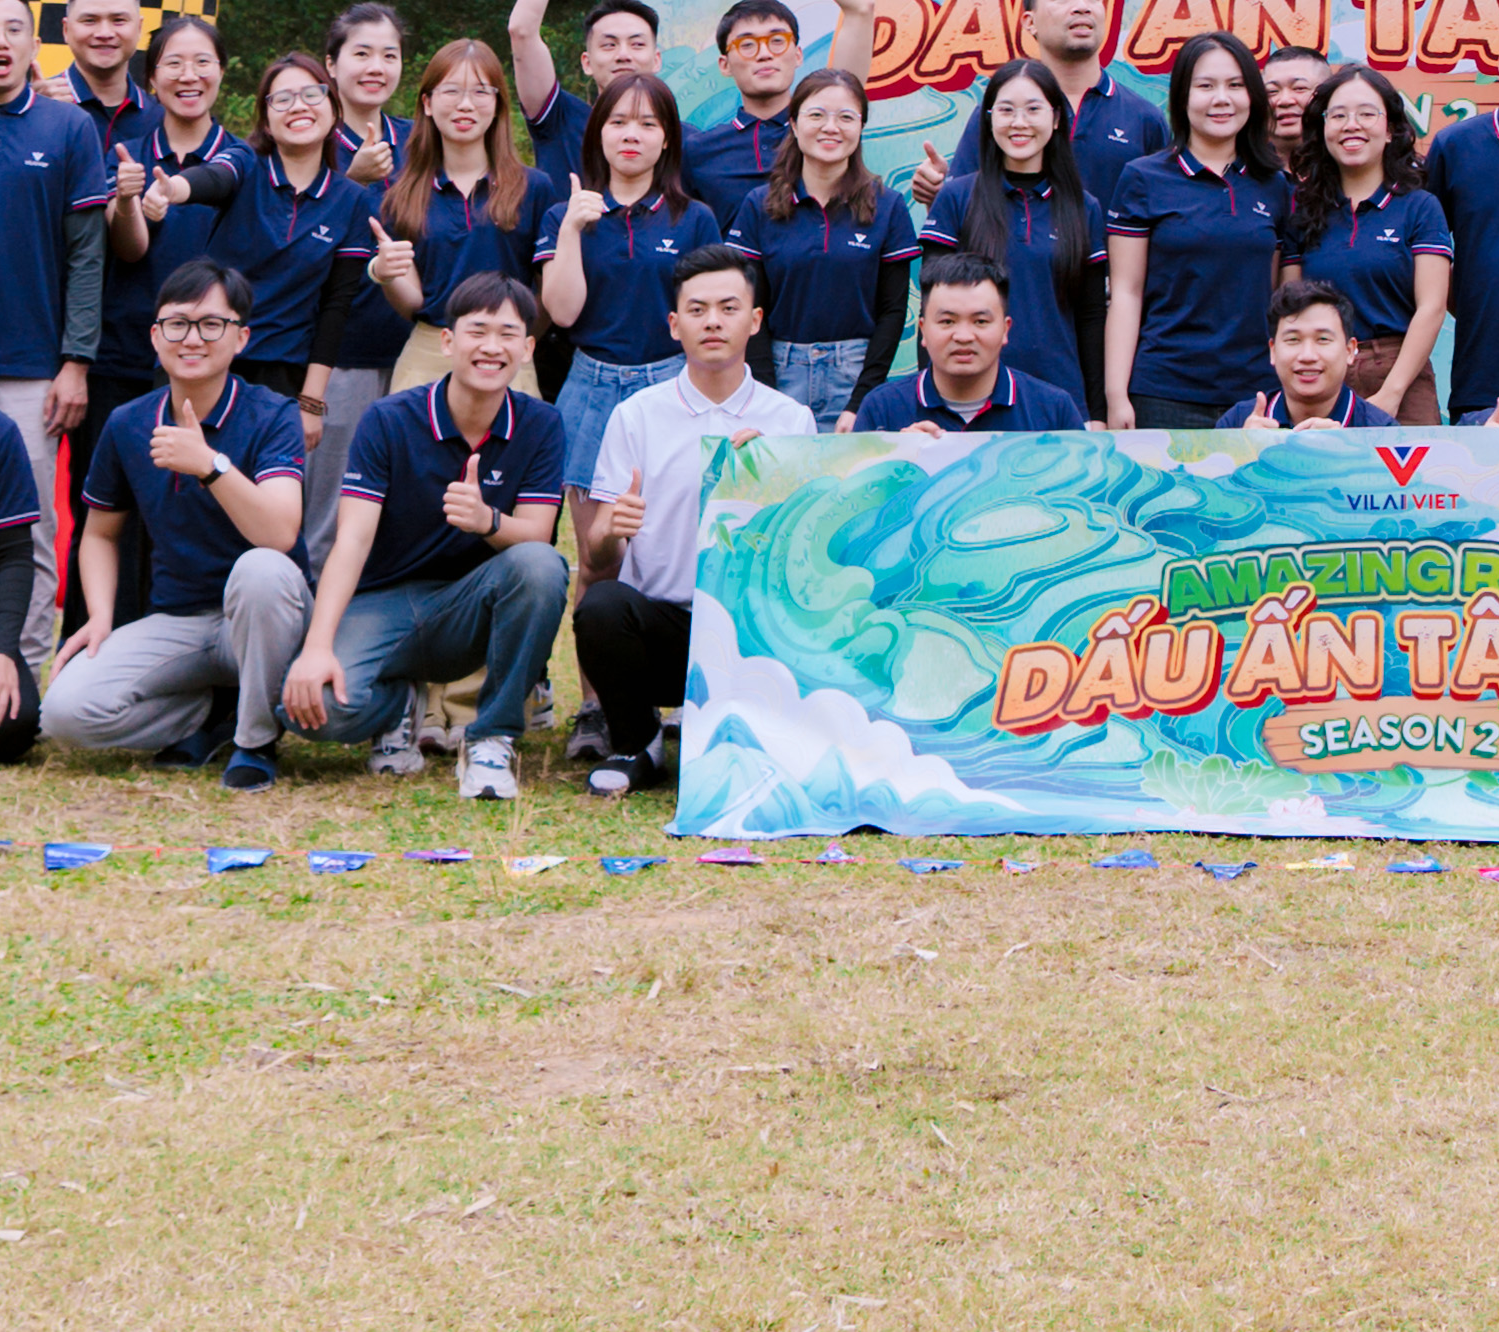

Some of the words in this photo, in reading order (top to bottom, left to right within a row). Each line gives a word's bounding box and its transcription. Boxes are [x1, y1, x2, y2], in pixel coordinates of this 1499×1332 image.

[1169, 549, 1451, 615] AMAZING
[995, 598, 1219, 726] DẤU
[1225, 585, 1380, 697] ẤN
[1299, 715, 1466, 758] SEASON
